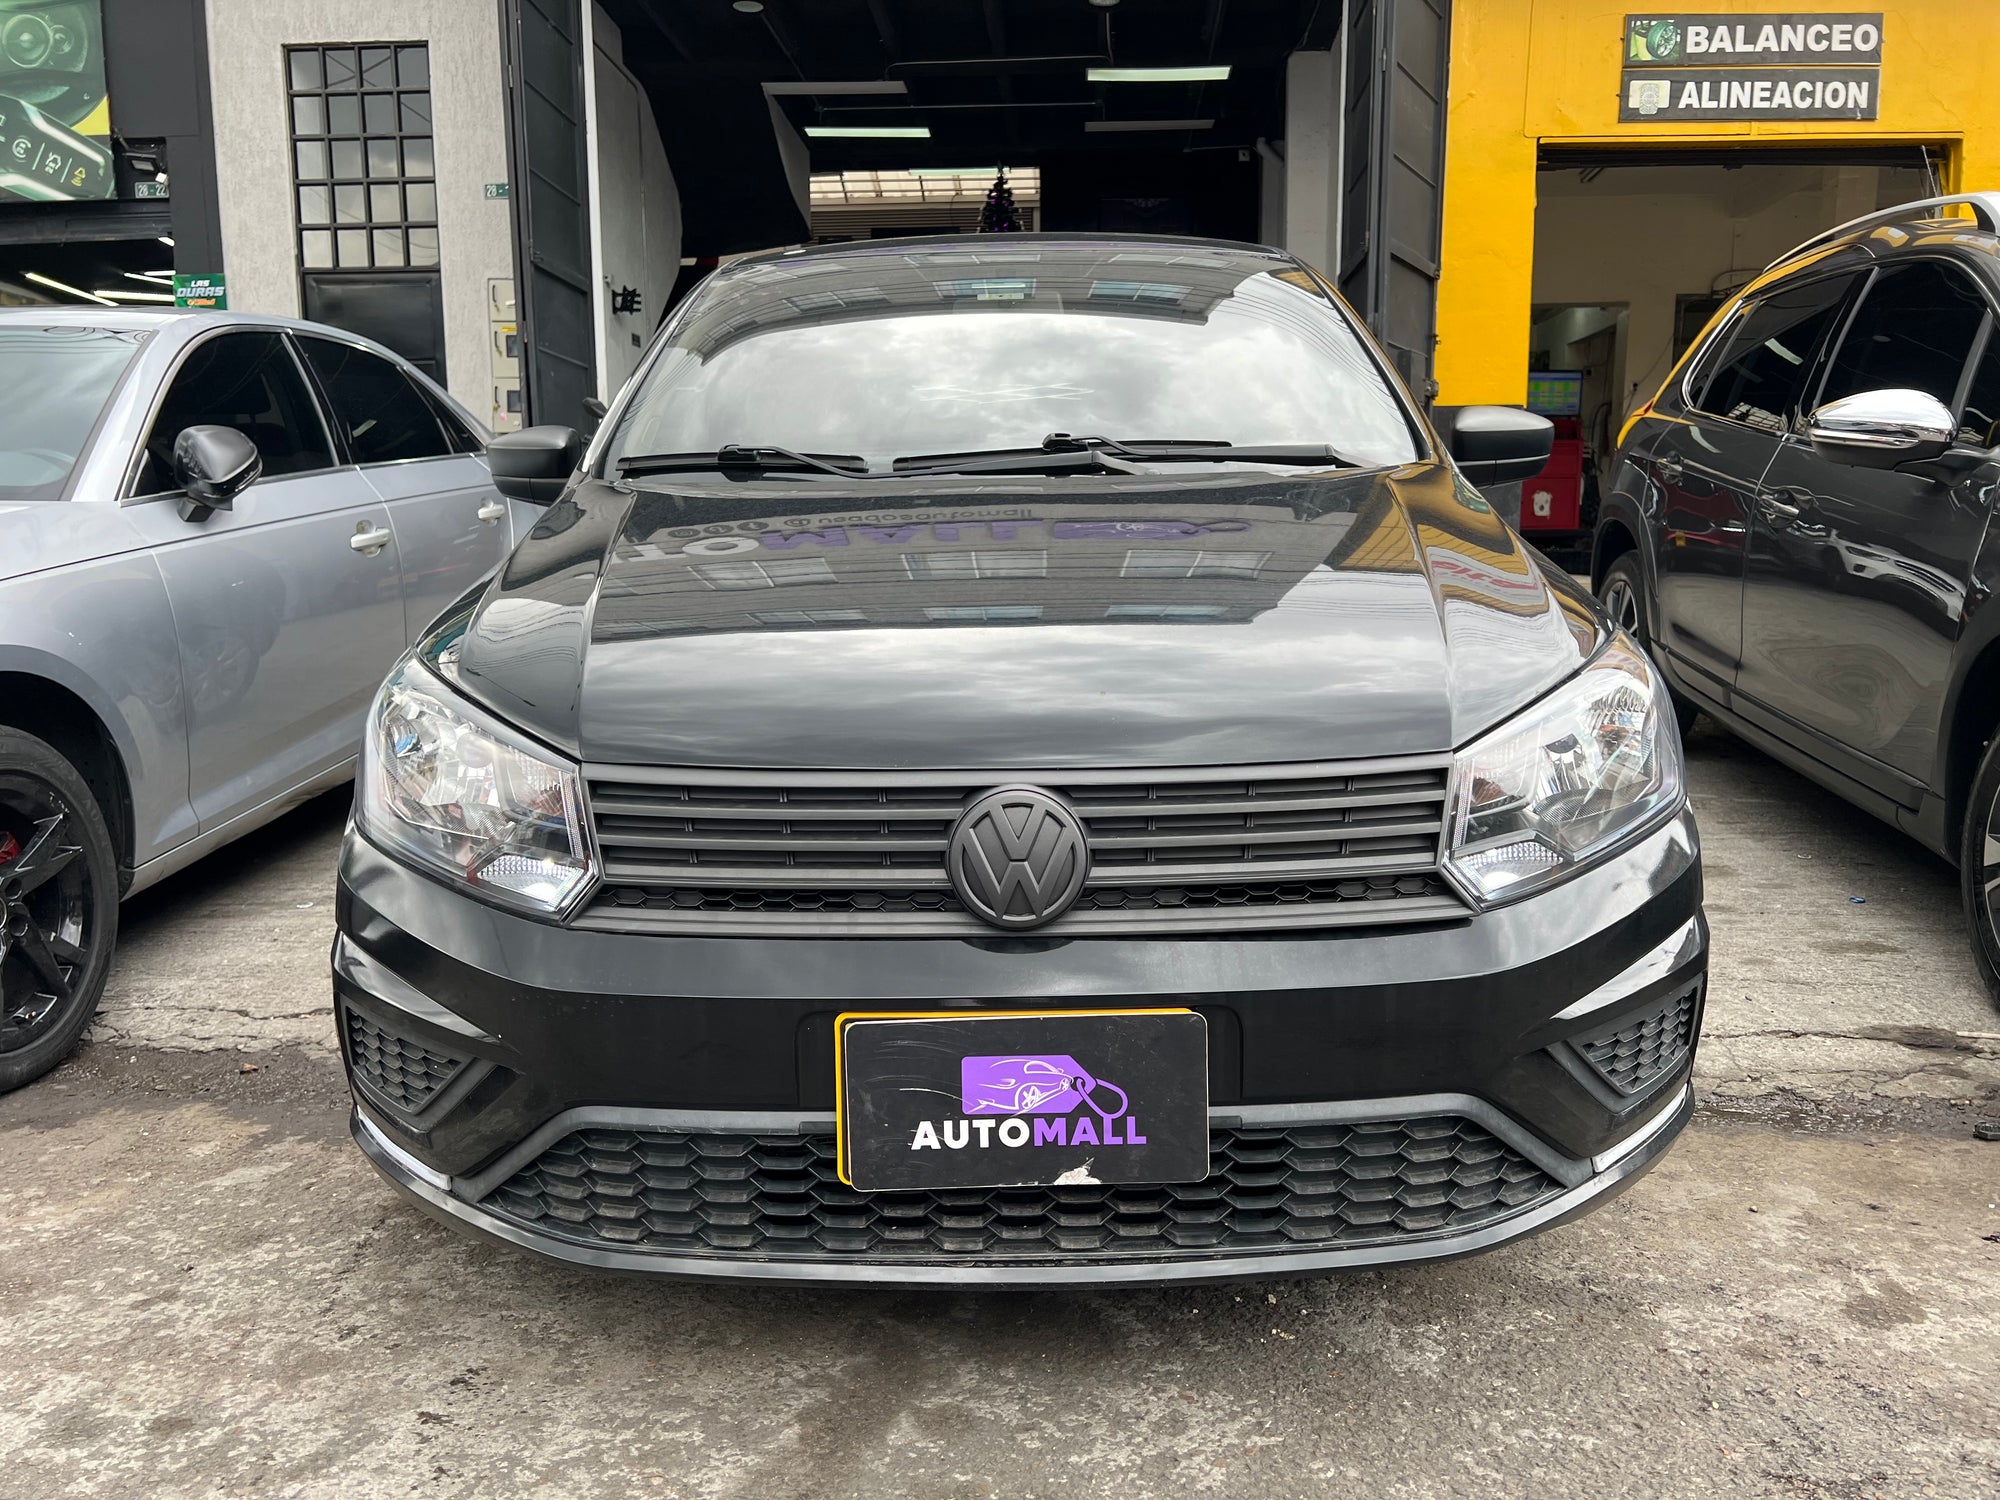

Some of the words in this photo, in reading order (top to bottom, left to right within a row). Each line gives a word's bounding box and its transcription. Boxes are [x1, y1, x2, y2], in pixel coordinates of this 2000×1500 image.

[1686, 23, 1879, 54] BALANCEO
[1677, 80, 1869, 109] ALINEACION
[486, 185, 497, 197] 28
[177, 287, 224, 297] DURAS
[910, 1116, 1147, 1151] AUTOMALL
